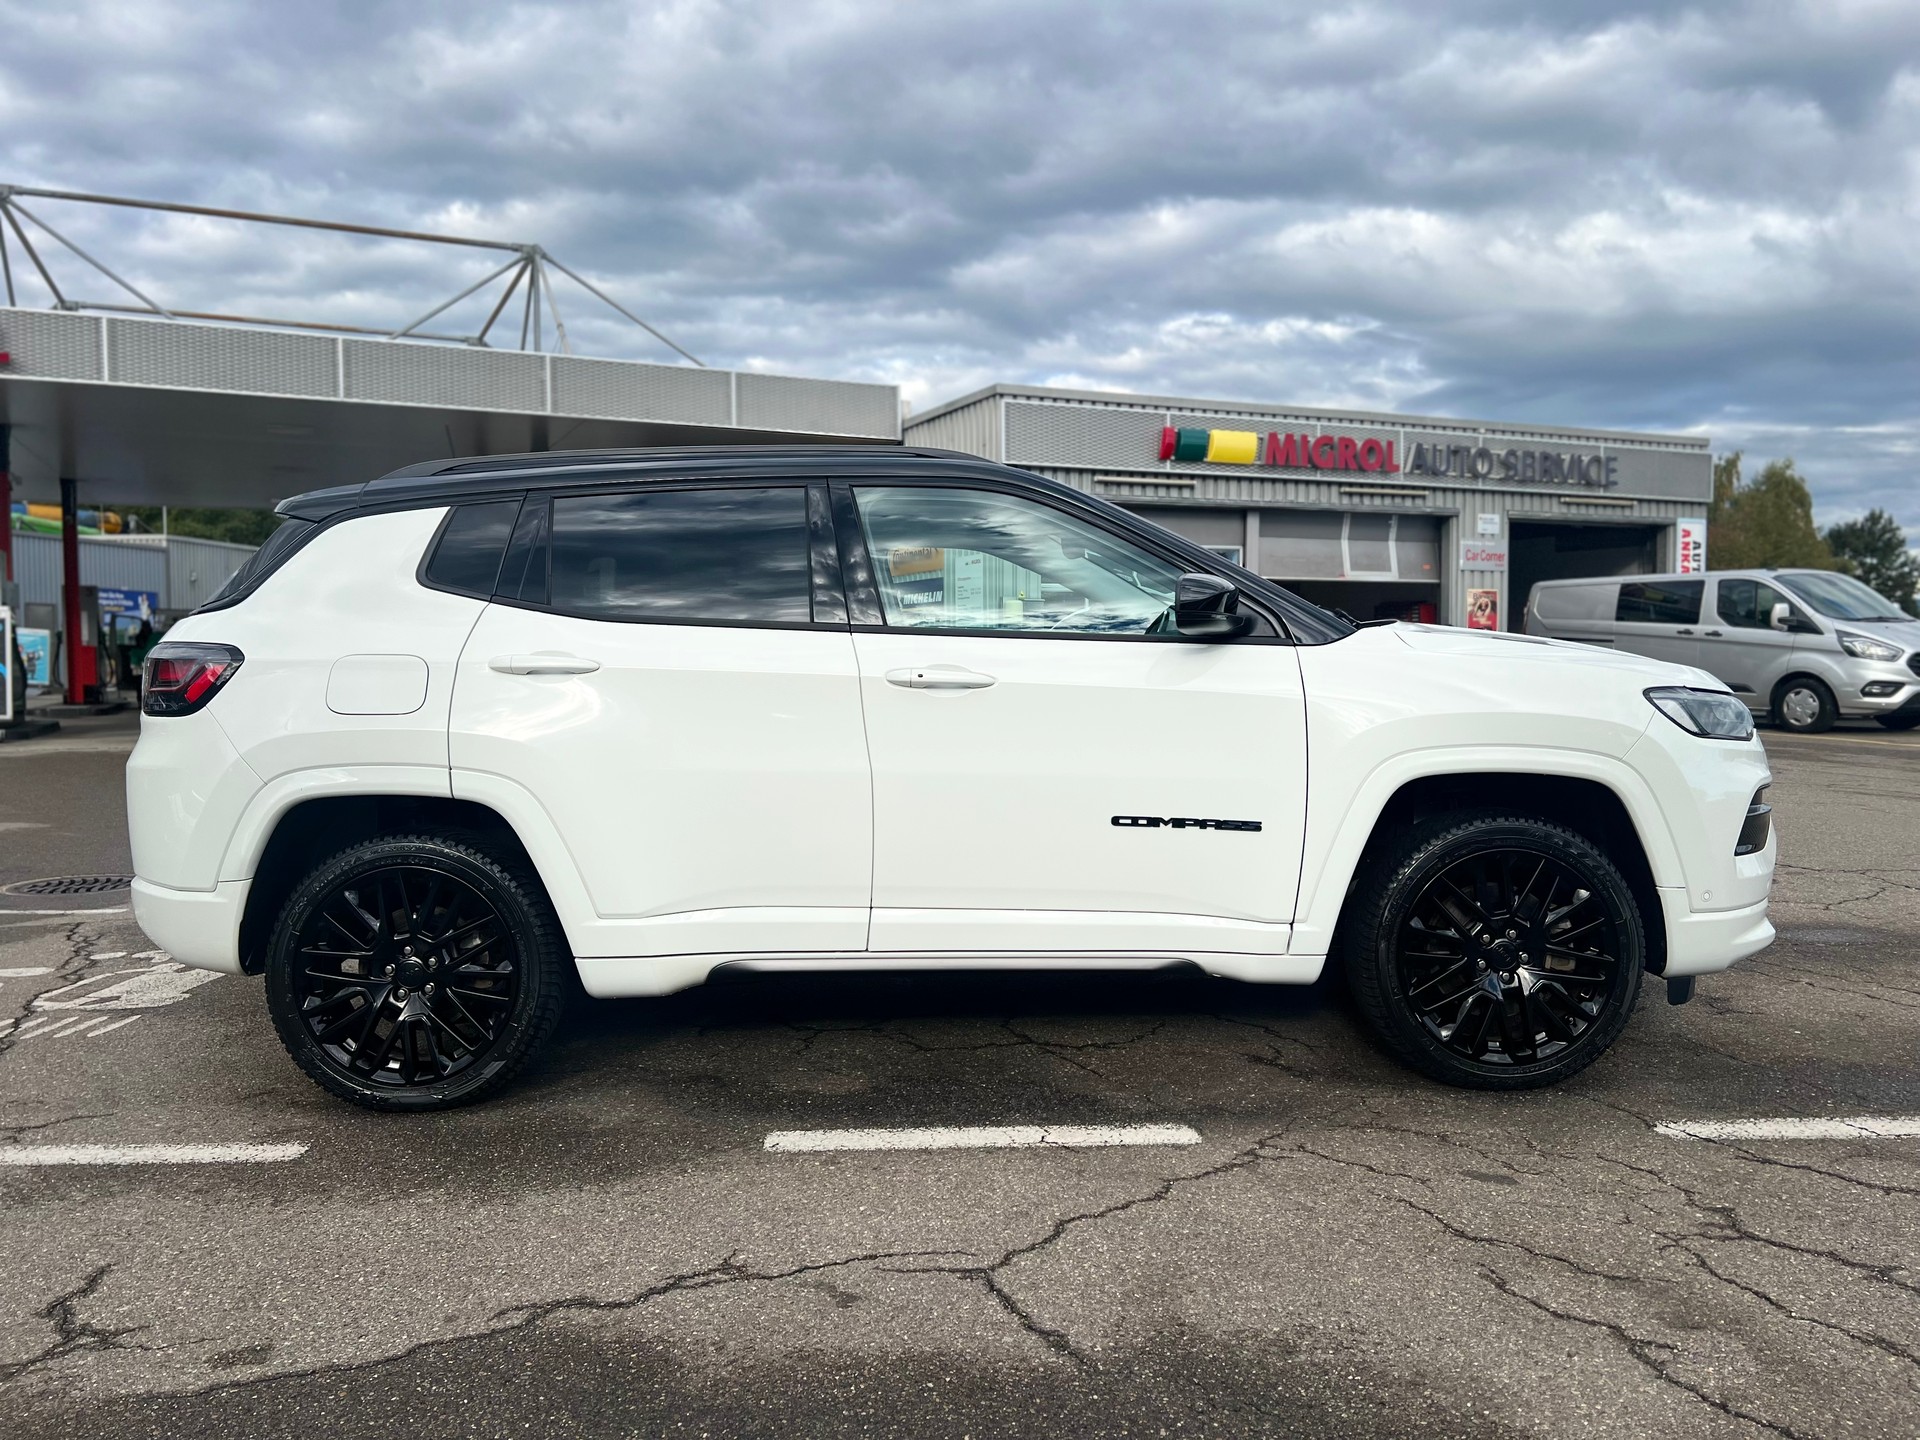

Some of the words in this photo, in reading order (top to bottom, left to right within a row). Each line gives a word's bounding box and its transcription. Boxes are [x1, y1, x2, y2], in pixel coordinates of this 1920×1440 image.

[1265, 432, 1400, 473] MIGROL
[1406, 442, 1494, 479] AUTO
[1501, 448, 1619, 488] SERVICE
[1465, 548, 1479, 561] Car
[1480, 549, 1505, 562] Corner
[903, 590, 943, 605] MICHELIN
[1111, 816, 1262, 832] COMPASS
